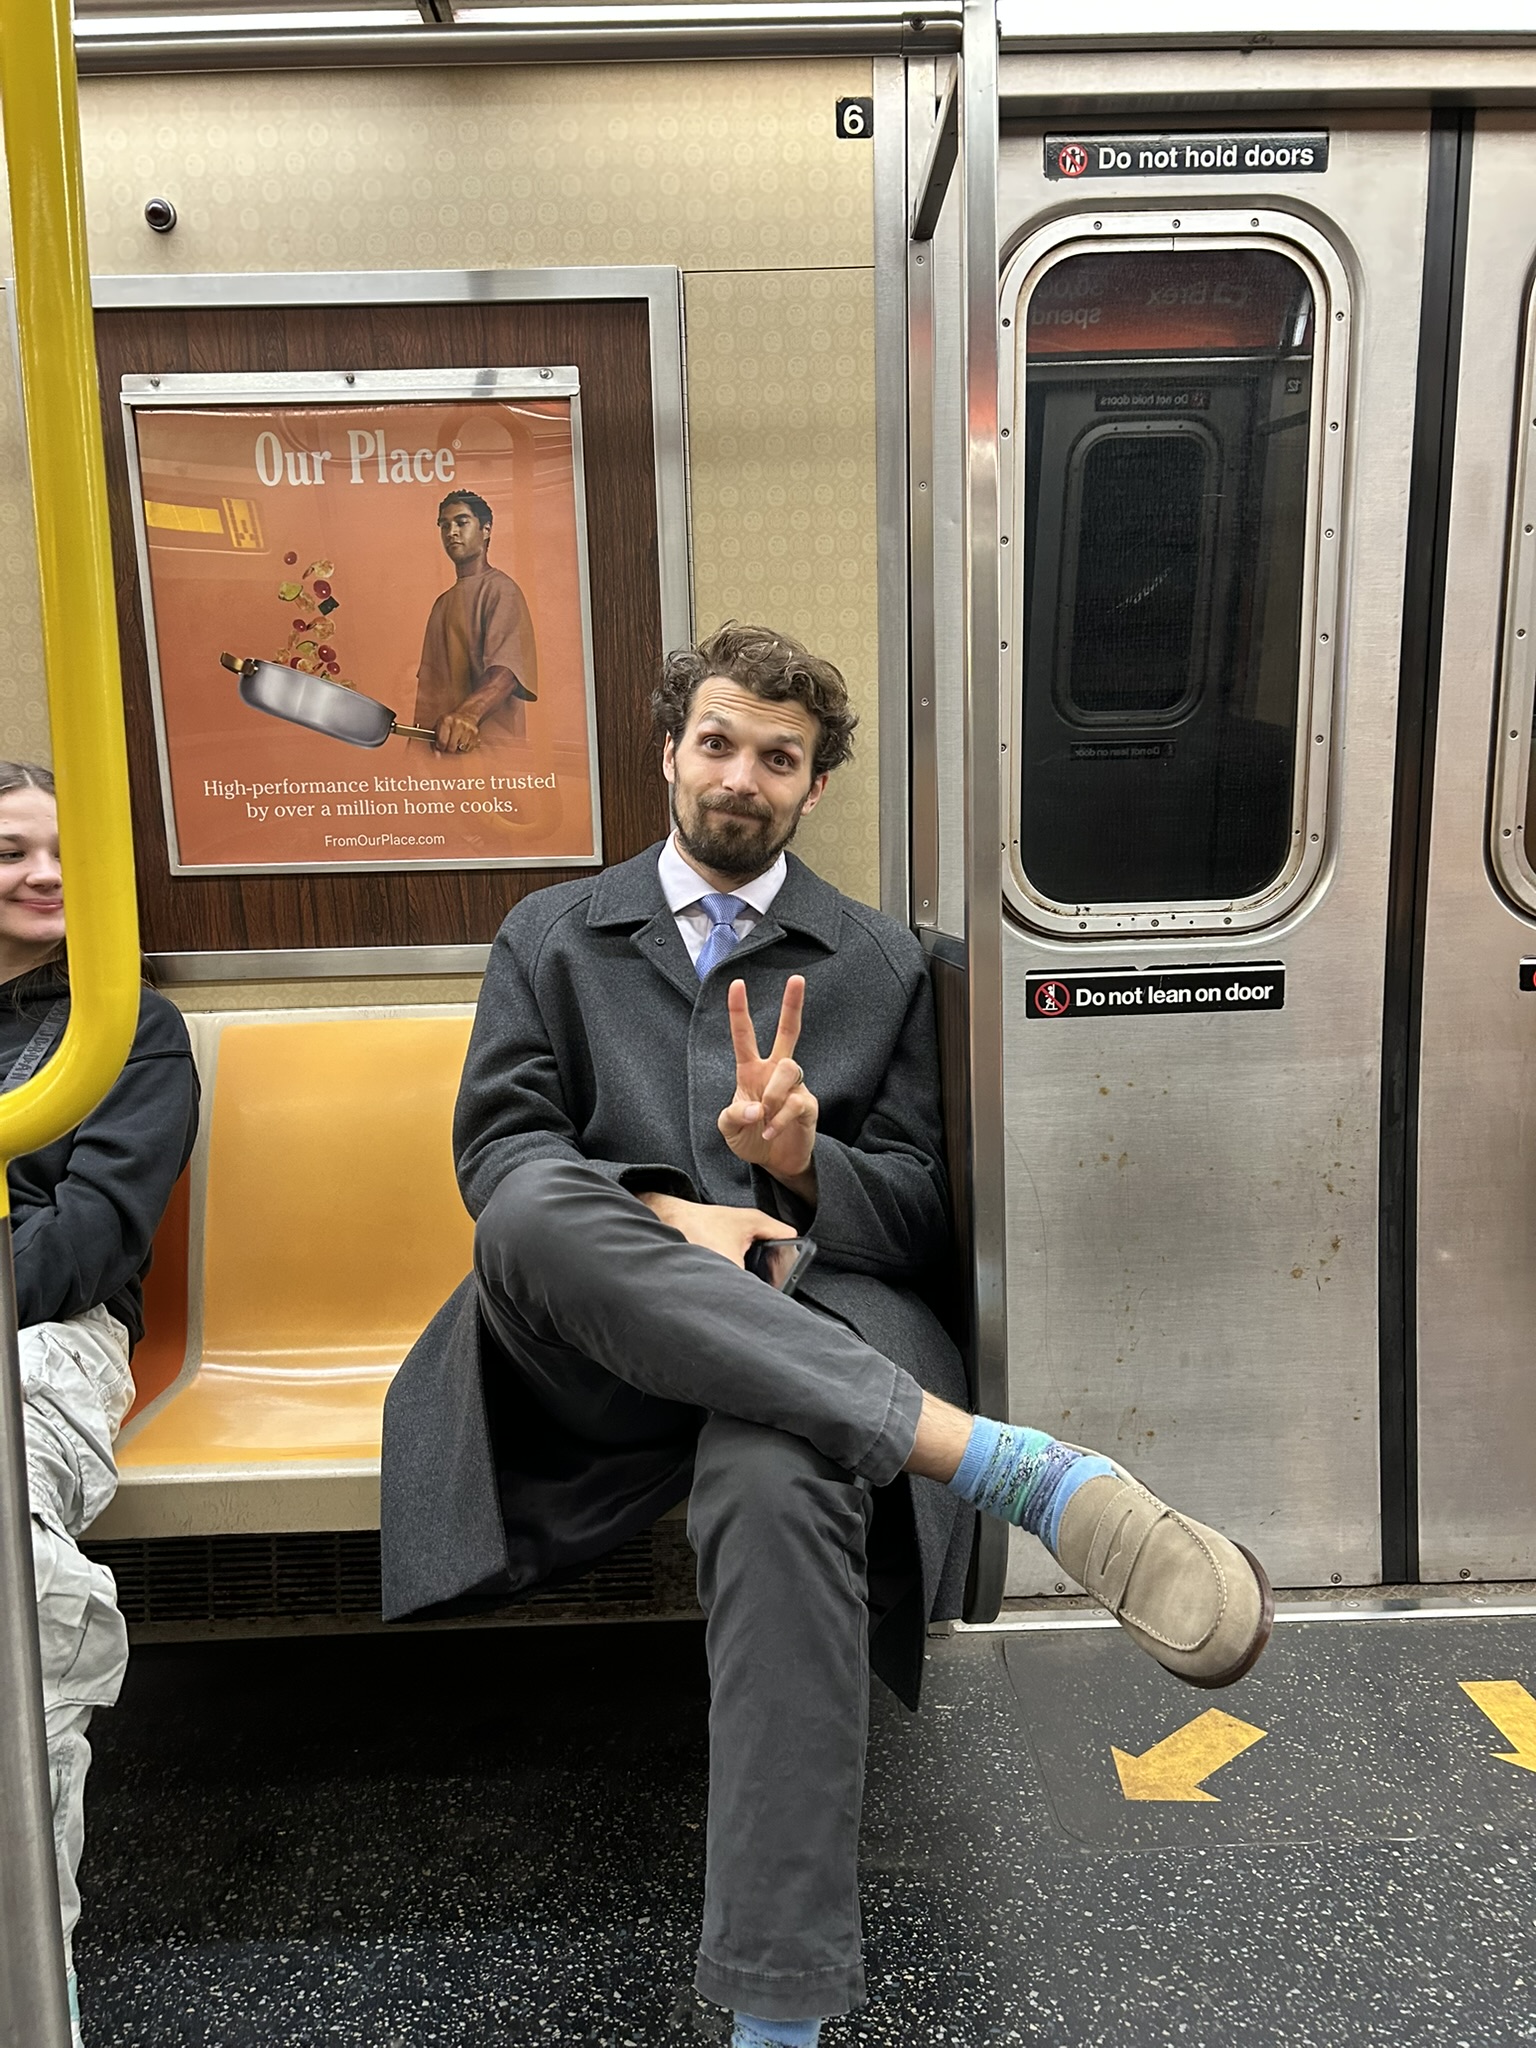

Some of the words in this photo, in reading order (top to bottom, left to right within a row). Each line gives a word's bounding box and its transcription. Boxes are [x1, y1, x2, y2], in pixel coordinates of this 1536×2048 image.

[843, 104, 865, 135] 6
[1098, 147, 1132, 170] Do
[1138, 147, 1178, 169] not
[1184, 144, 1237, 168] hold
[1244, 144, 1315, 166] doors
[255, 431, 332, 487] Our
[203, 778, 370, 800] High-performance
[373, 775, 486, 793] kitchenware
[490, 773, 557, 790] trusted
[246, 802, 269, 822] by
[274, 804, 315, 818] over
[321, 803, 332, 817] a
[336, 799, 399, 817] million
[403, 799, 455, 815] home
[460, 797, 519, 814] cooks.
[325, 833, 446, 847] FromOurPlace.com
[1075, 988, 1105, 1007] Do
[1108, 987, 1143, 1005] not
[1148, 985, 1192, 1005] lean
[1195, 987, 1221, 1003] on
[1225, 983, 1274, 1001] door
[9, 1030, 56, 1081] JORDAN
